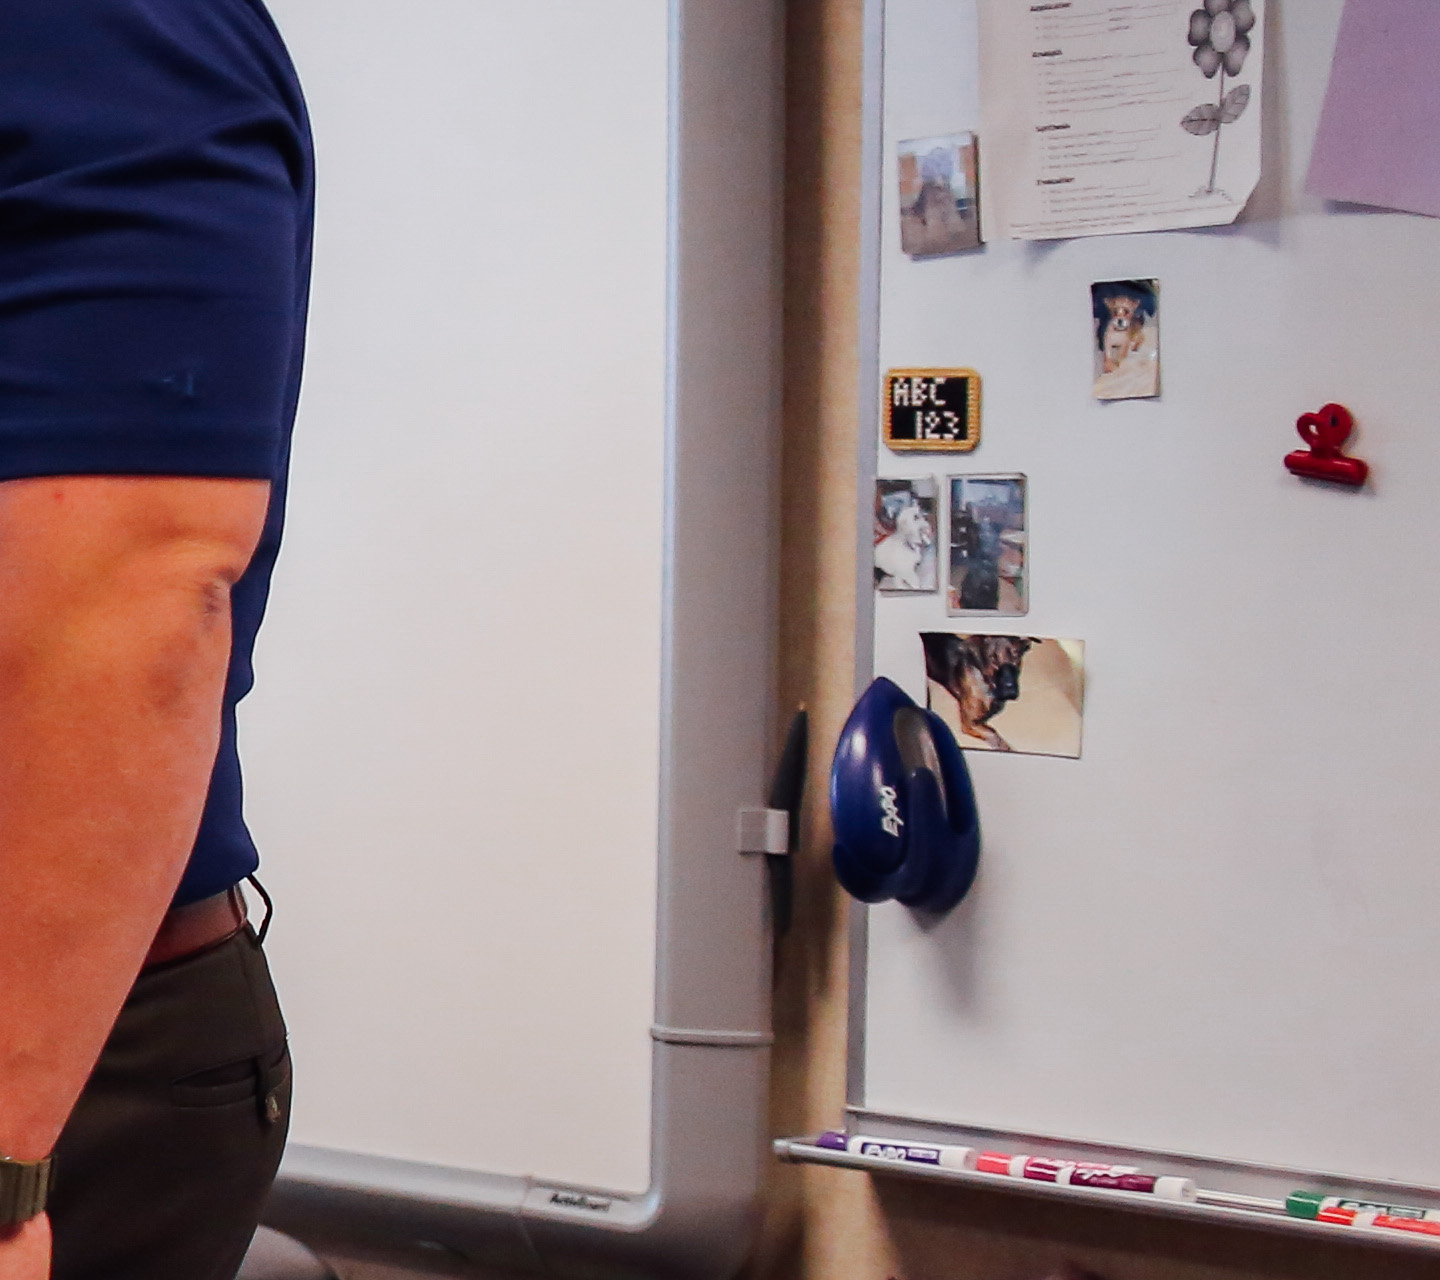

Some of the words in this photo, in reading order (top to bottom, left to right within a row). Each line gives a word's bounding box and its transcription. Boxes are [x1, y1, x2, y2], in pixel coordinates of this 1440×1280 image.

[893, 377, 947, 407] ABC
[915, 410, 960, 439] 123
[880, 786, 905, 837] EXPO
